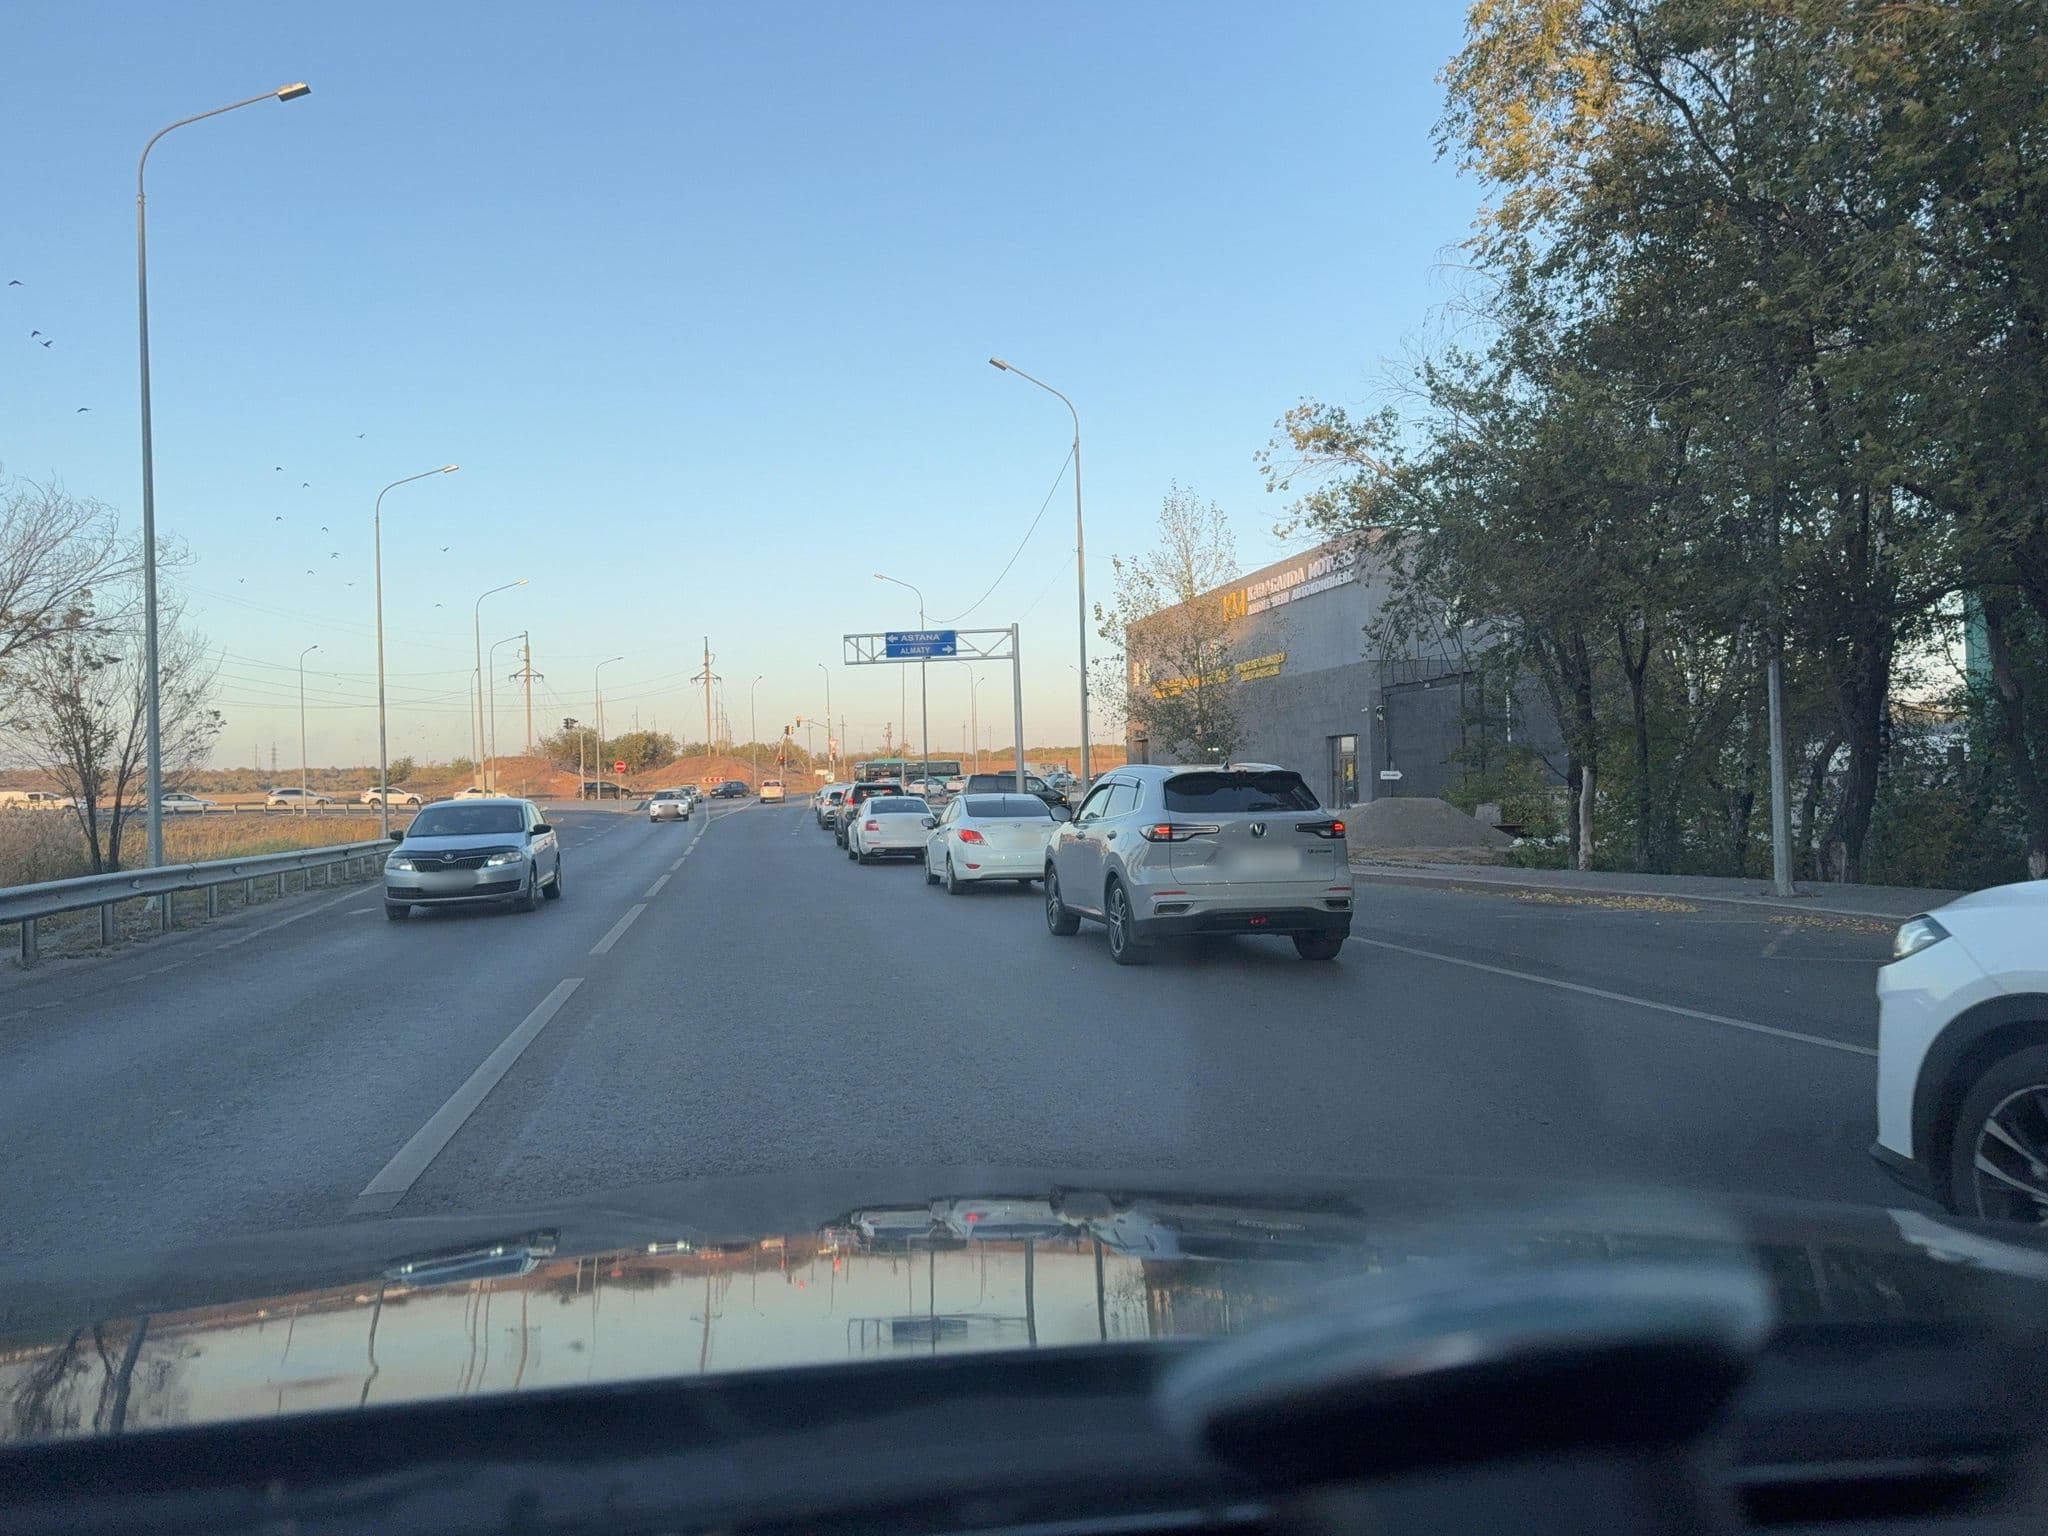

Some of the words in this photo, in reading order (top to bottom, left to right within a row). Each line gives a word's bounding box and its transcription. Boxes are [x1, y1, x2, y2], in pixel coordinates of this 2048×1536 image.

[1247, 567, 1305, 601] KARAGANDA
[901, 633, 940, 642] ASTANA
[900, 646, 930, 655] ALMATY
